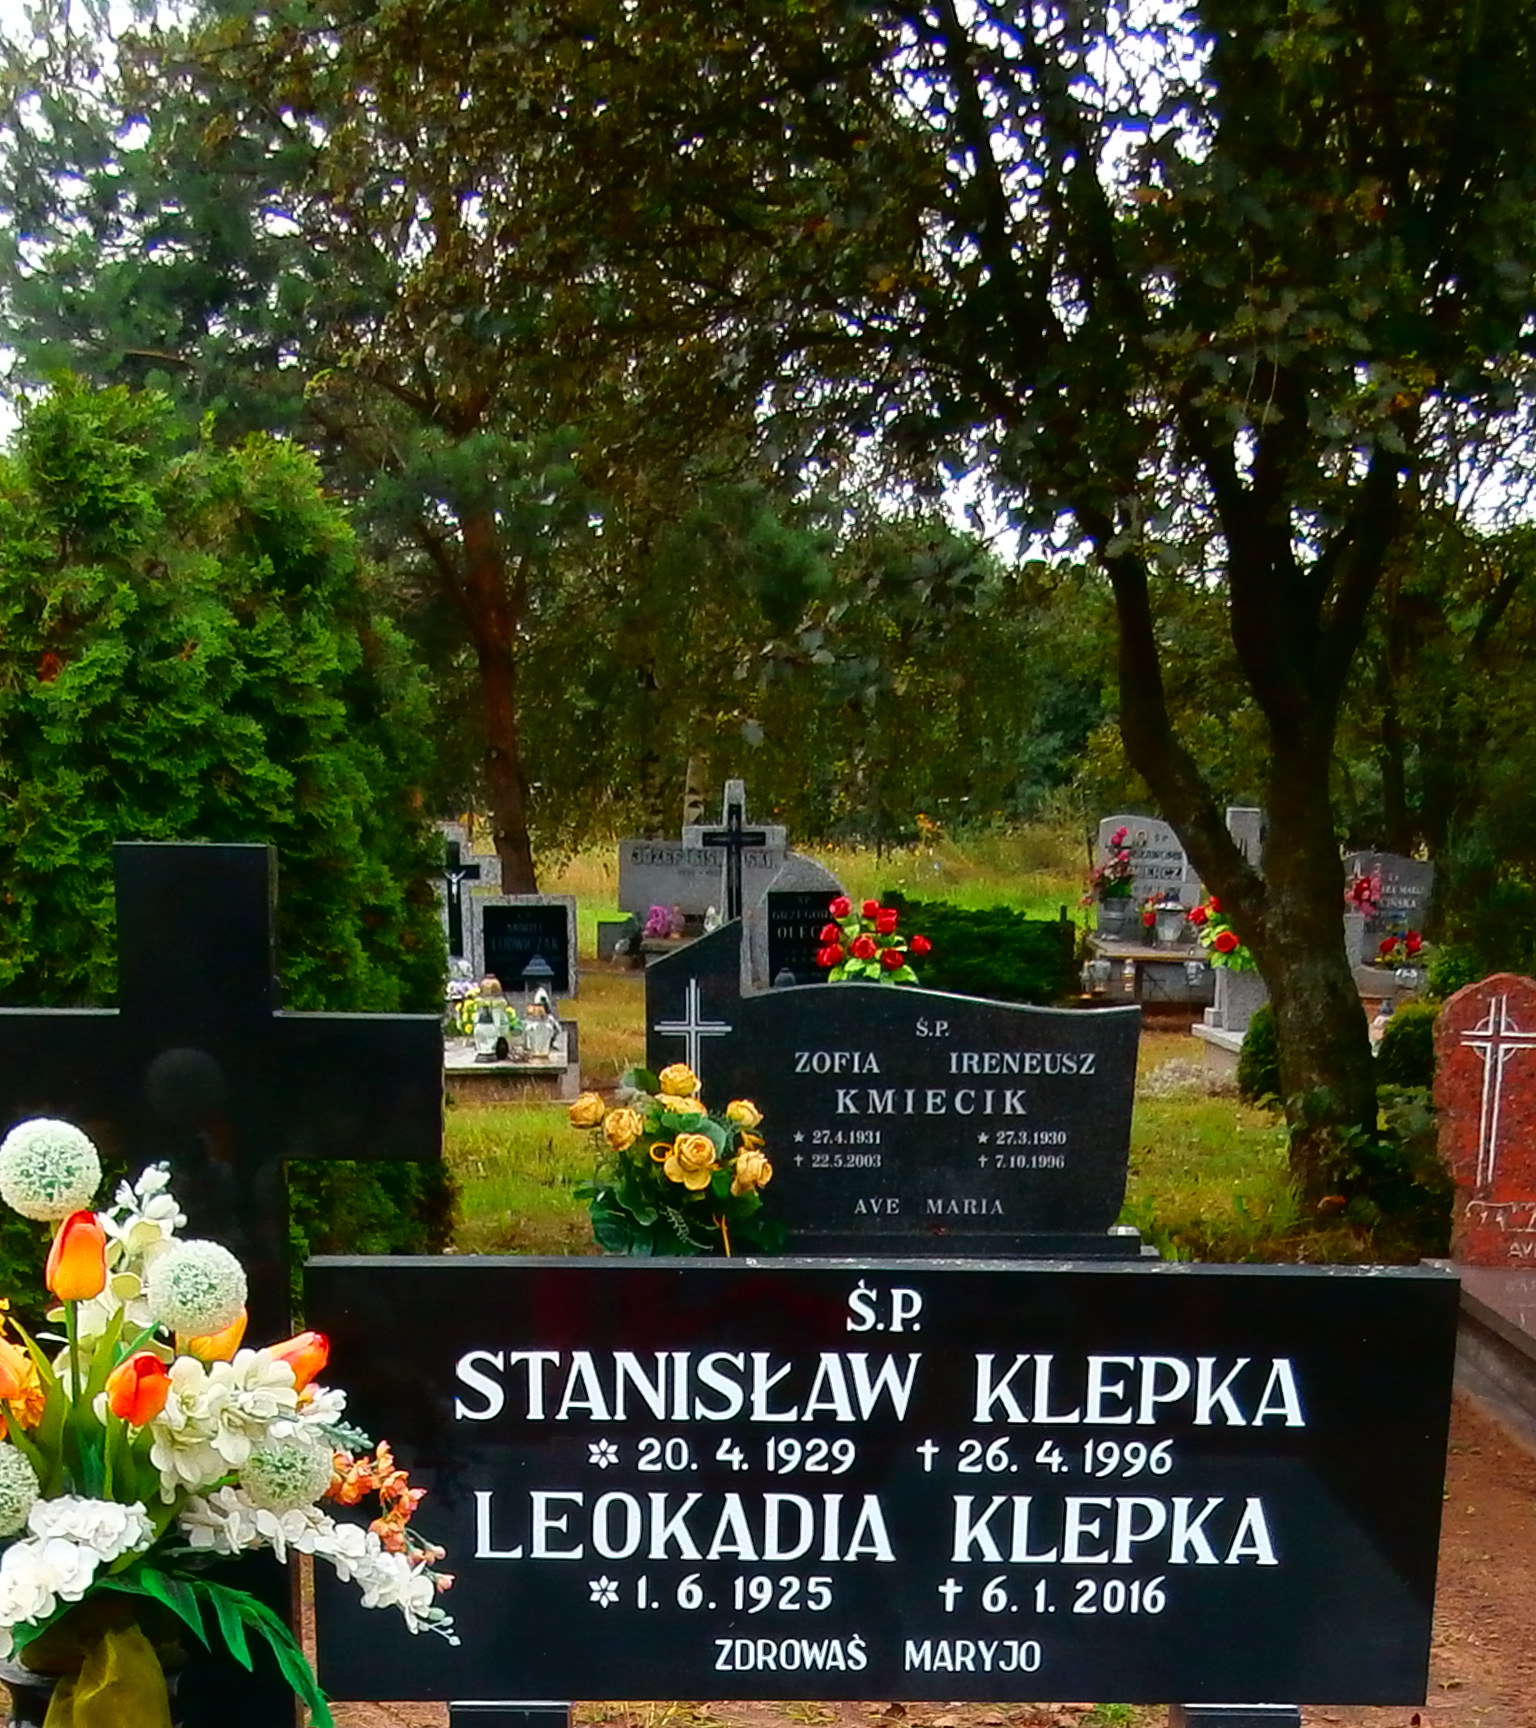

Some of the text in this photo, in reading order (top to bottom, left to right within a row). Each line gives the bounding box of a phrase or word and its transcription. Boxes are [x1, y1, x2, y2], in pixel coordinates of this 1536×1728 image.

[795, 1052, 1096, 1075] ZOFIA IRENEUSZ
[835, 1088, 1027, 1115] KMIECIK
[812, 1130, 882, 1145] 27.4.1931
[811, 1154, 882, 1168] 22.5.2003
[854, 1199, 1004, 1215] AVE MARIA
[846, 1279, 922, 1332] Ś.P.
[454, 1350, 1306, 1427] STANISŁAW KLEPKA
[637, 1437, 856, 1475] 20. 4. 1929
[958, 1436, 1174, 1477] 26. 4. 1996
[473, 1490, 1279, 1565] LEOKADIA KLEPKA
[676, 1573, 717, 1610] 6.
[733, 1576, 833, 1614] 1925
[982, 1575, 1019, 1614] 6.
[1073, 1576, 1166, 1614] 2016
[714, 1634, 1042, 1672] ZDROWAŚ MARYJO
